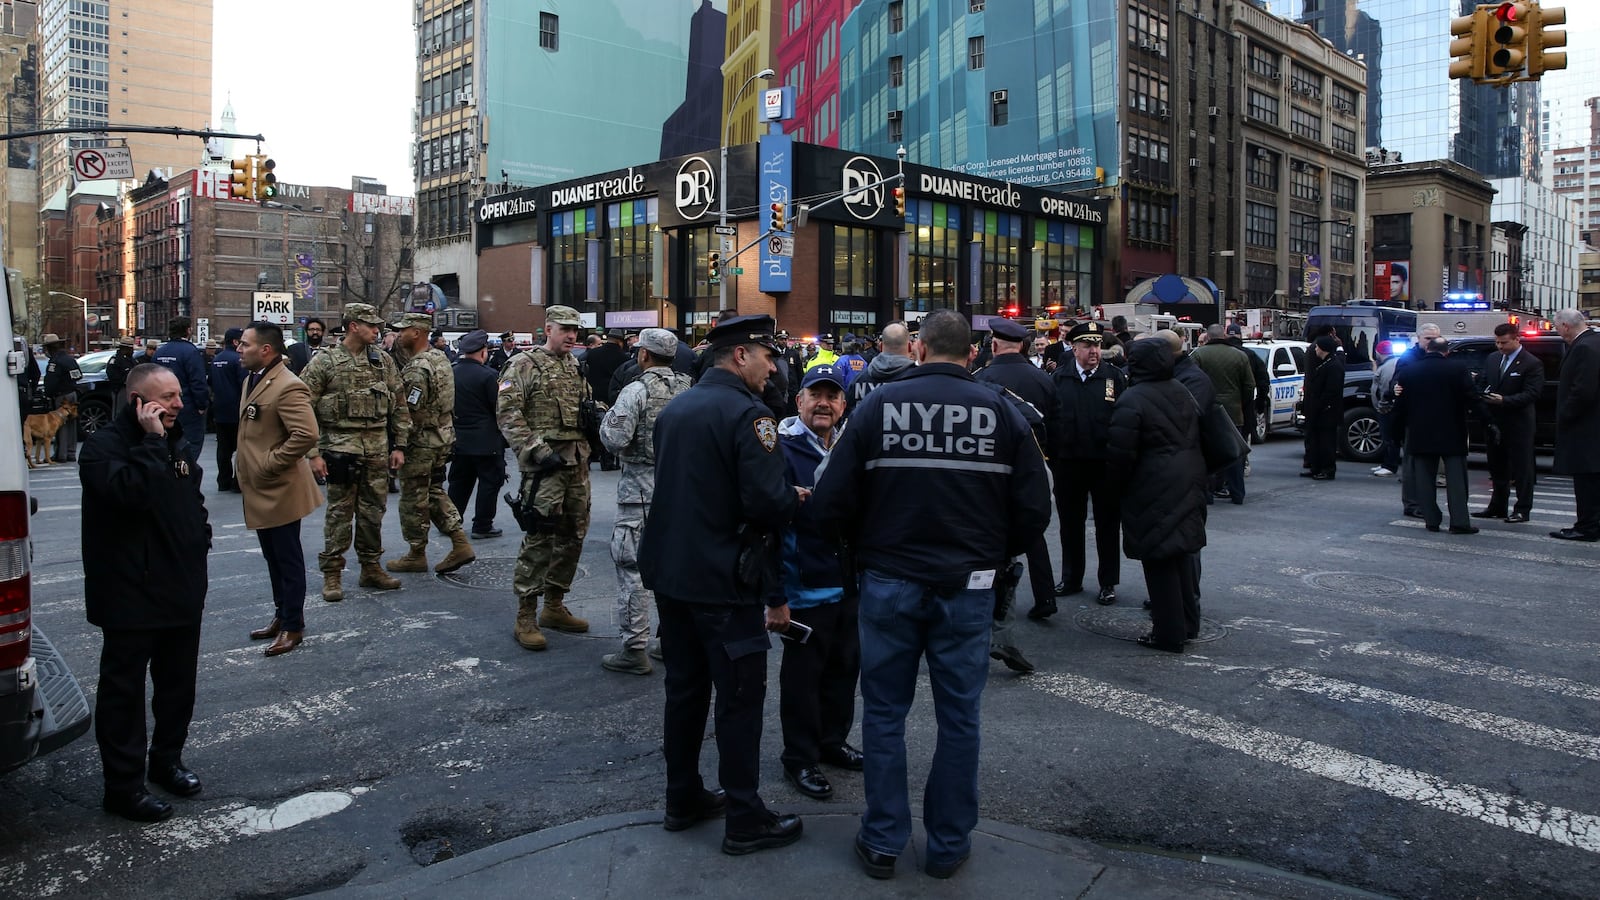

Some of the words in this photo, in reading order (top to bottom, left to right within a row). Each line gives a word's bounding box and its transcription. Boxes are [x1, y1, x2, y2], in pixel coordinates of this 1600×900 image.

[966, 161, 985, 171] Corp.
[986, 156, 1020, 168] Licensed
[1021, 151, 1057, 163] Mortgage
[1058, 147, 1086, 158] Banker
[976, 166, 1007, 178] Services
[1008, 164, 1035, 175] license
[1036, 161, 1066, 171] number
[1067, 156, 1093, 167] 10893;
[1051, 171, 1065, 180] CA
[1065, 167, 1094, 178] 95448.
[763, 180, 788, 277] phcy
[257, 300, 290, 314] PARK
[854, 382, 886, 400] NY
[1275, 386, 1295, 400] NYPD
[882, 402, 997, 436] NYPD
[882, 433, 996, 457] POLICE
